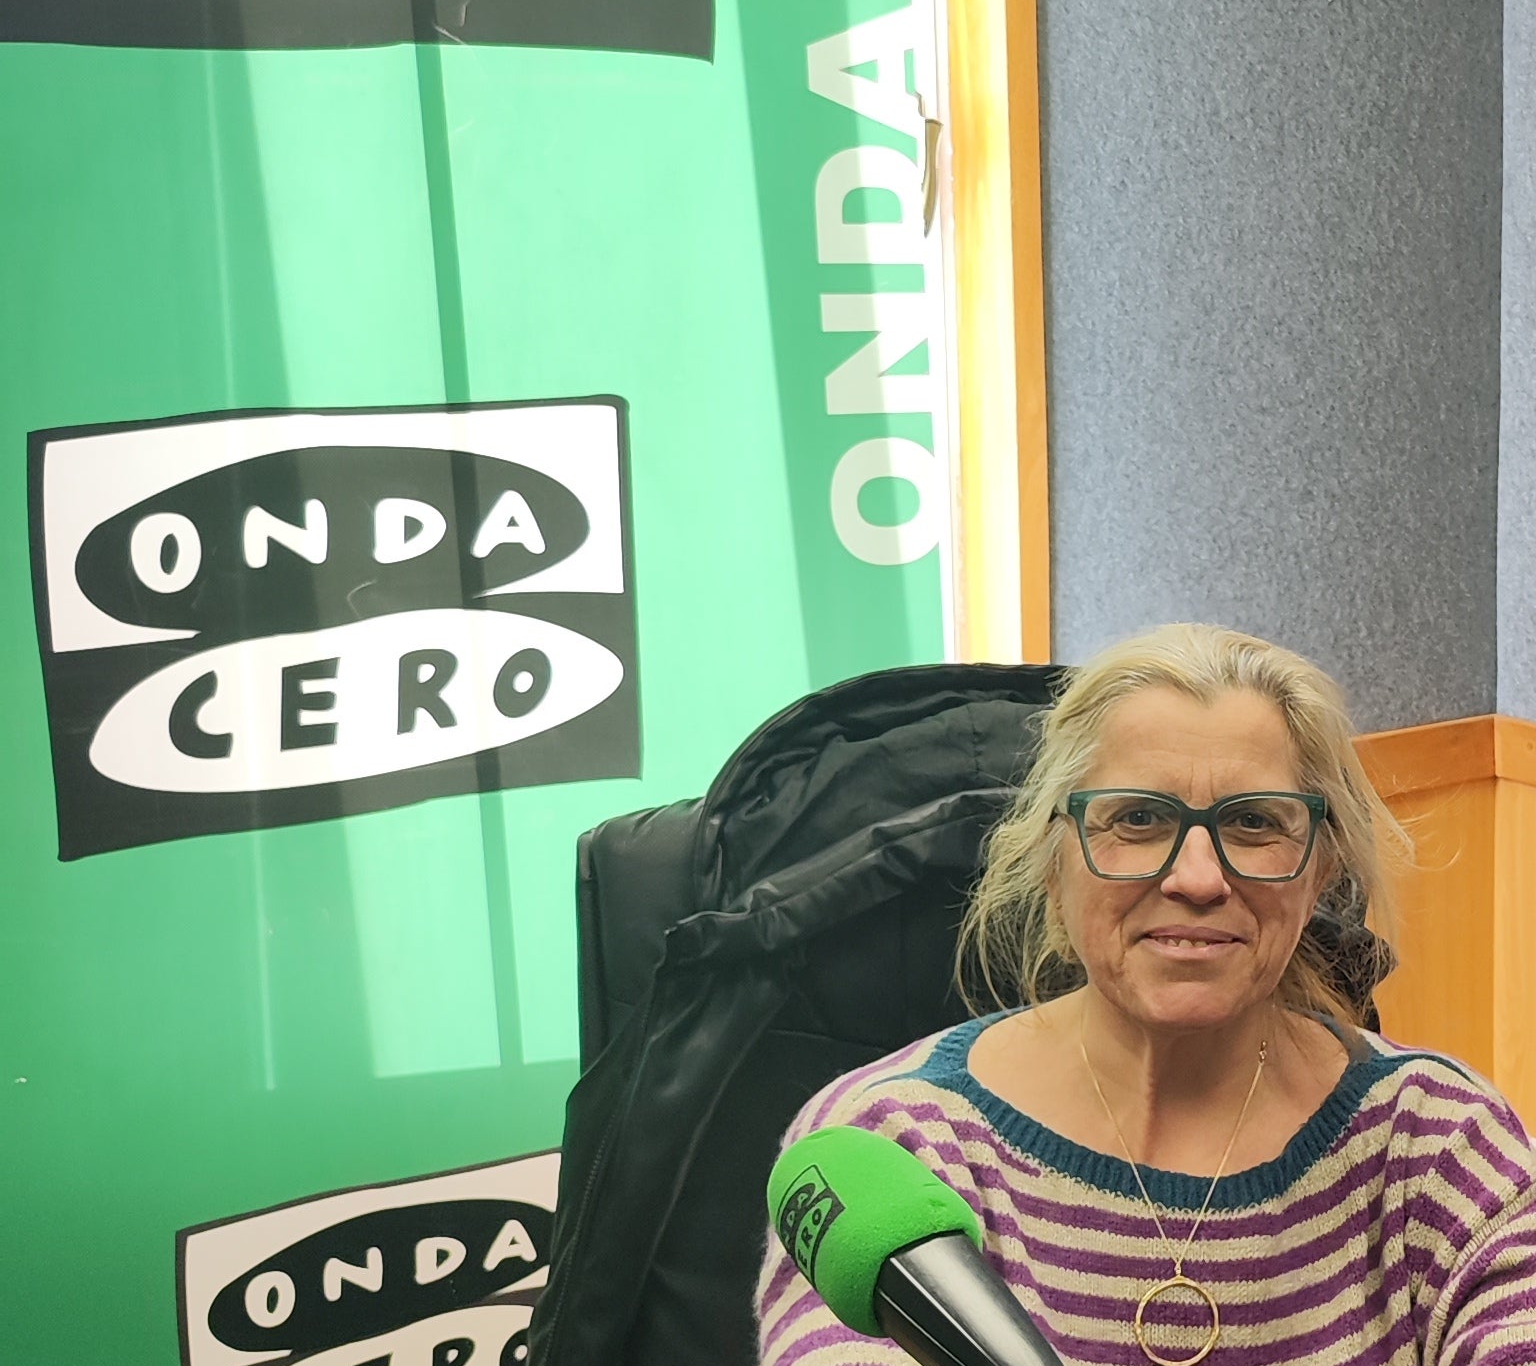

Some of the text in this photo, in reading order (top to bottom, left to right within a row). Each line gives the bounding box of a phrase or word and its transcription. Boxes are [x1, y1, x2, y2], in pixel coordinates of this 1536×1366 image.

[806, 1, 938, 565] ONDA
[129, 490, 547, 594] ONDA
[168, 647, 552, 760] CERO
[244, 1219, 537, 1328] ONDA
[797, 1208, 822, 1270] ERO
